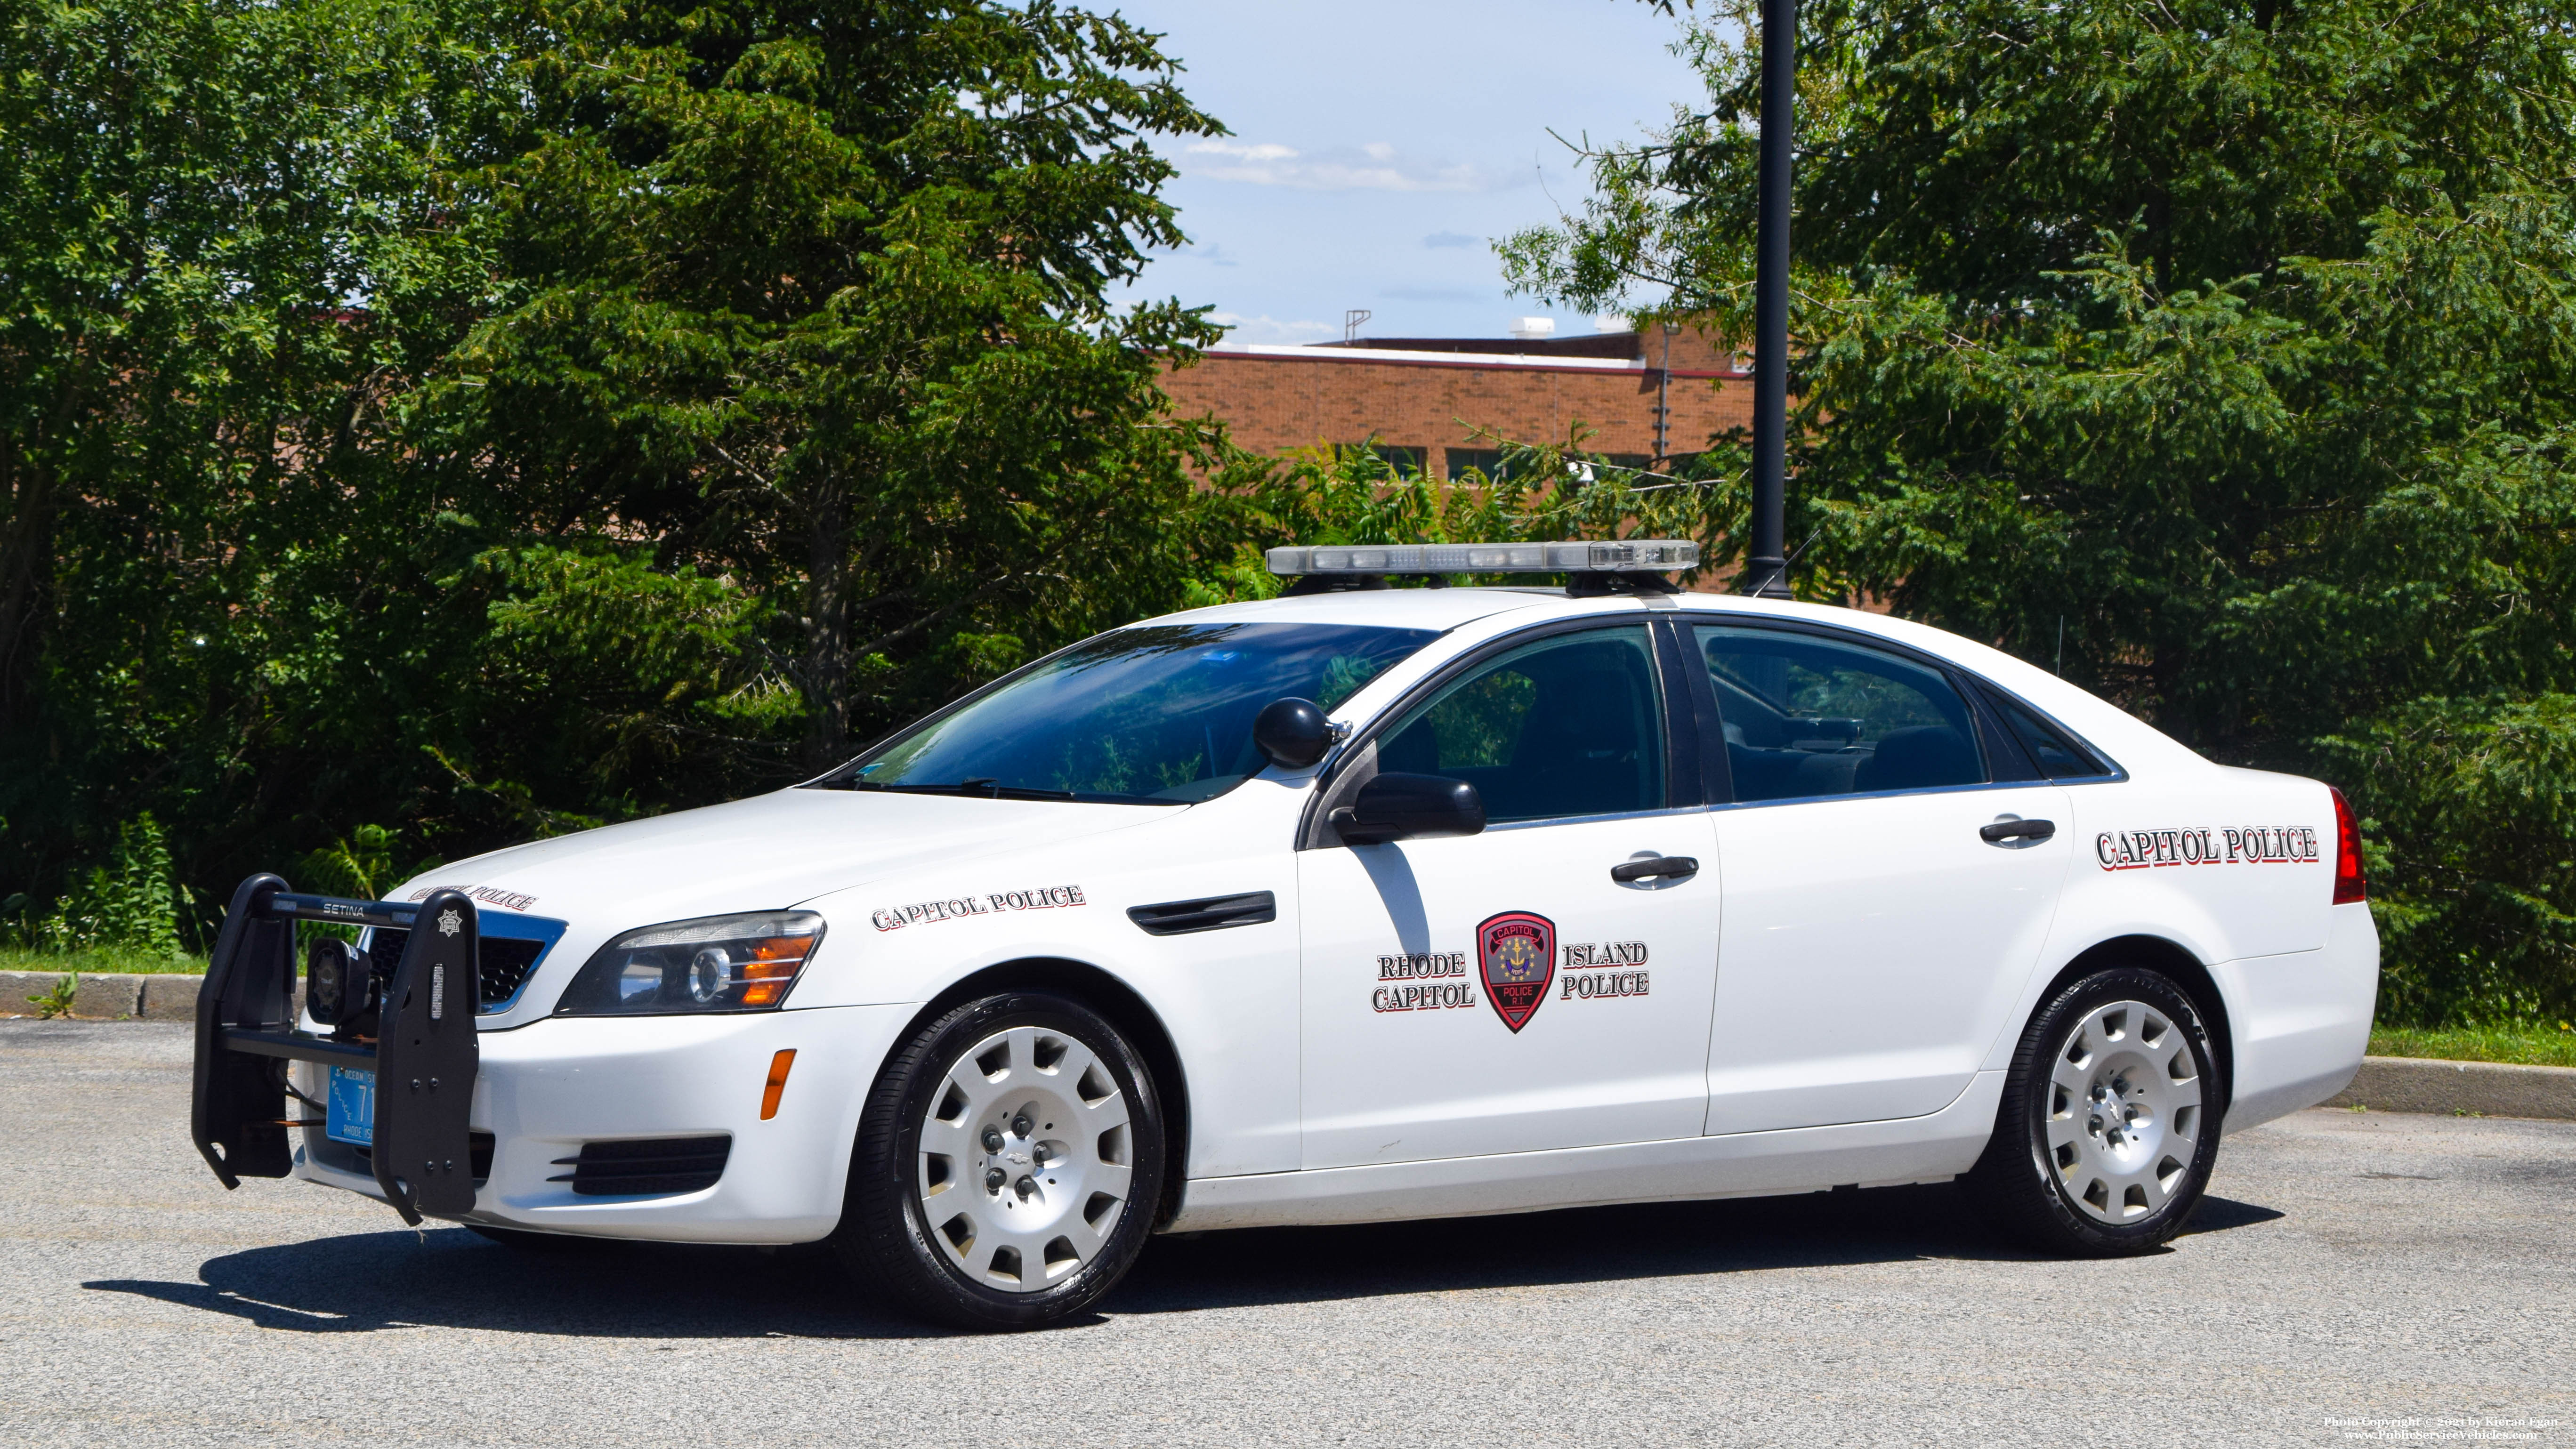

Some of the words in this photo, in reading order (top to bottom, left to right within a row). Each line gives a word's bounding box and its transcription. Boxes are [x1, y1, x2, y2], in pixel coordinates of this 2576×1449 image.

[2095, 827, 2221, 871] CAPITOL
[2221, 826, 2319, 863] POLICE
[468, 886, 539, 911] POLICE
[323, 903, 364, 917] SETINA
[870, 896, 988, 932] CAPITOL
[986, 885, 1086, 911] POLICE
[1497, 926, 1534, 938] CAPITOL
[1377, 951, 1466, 981] RHODE
[1562, 941, 1648, 969] ISLAND
[1371, 982, 1476, 1012] CAPITOL
[1560, 971, 1649, 1000] POLICE
[1503, 987, 1533, 997] POLICE
[1512, 997, 1525, 1005] R.I.
[345, 1070, 363, 1081] OCEAN
[332, 1080, 353, 1120] POLICE
[343, 1124, 362, 1138] RHODE
